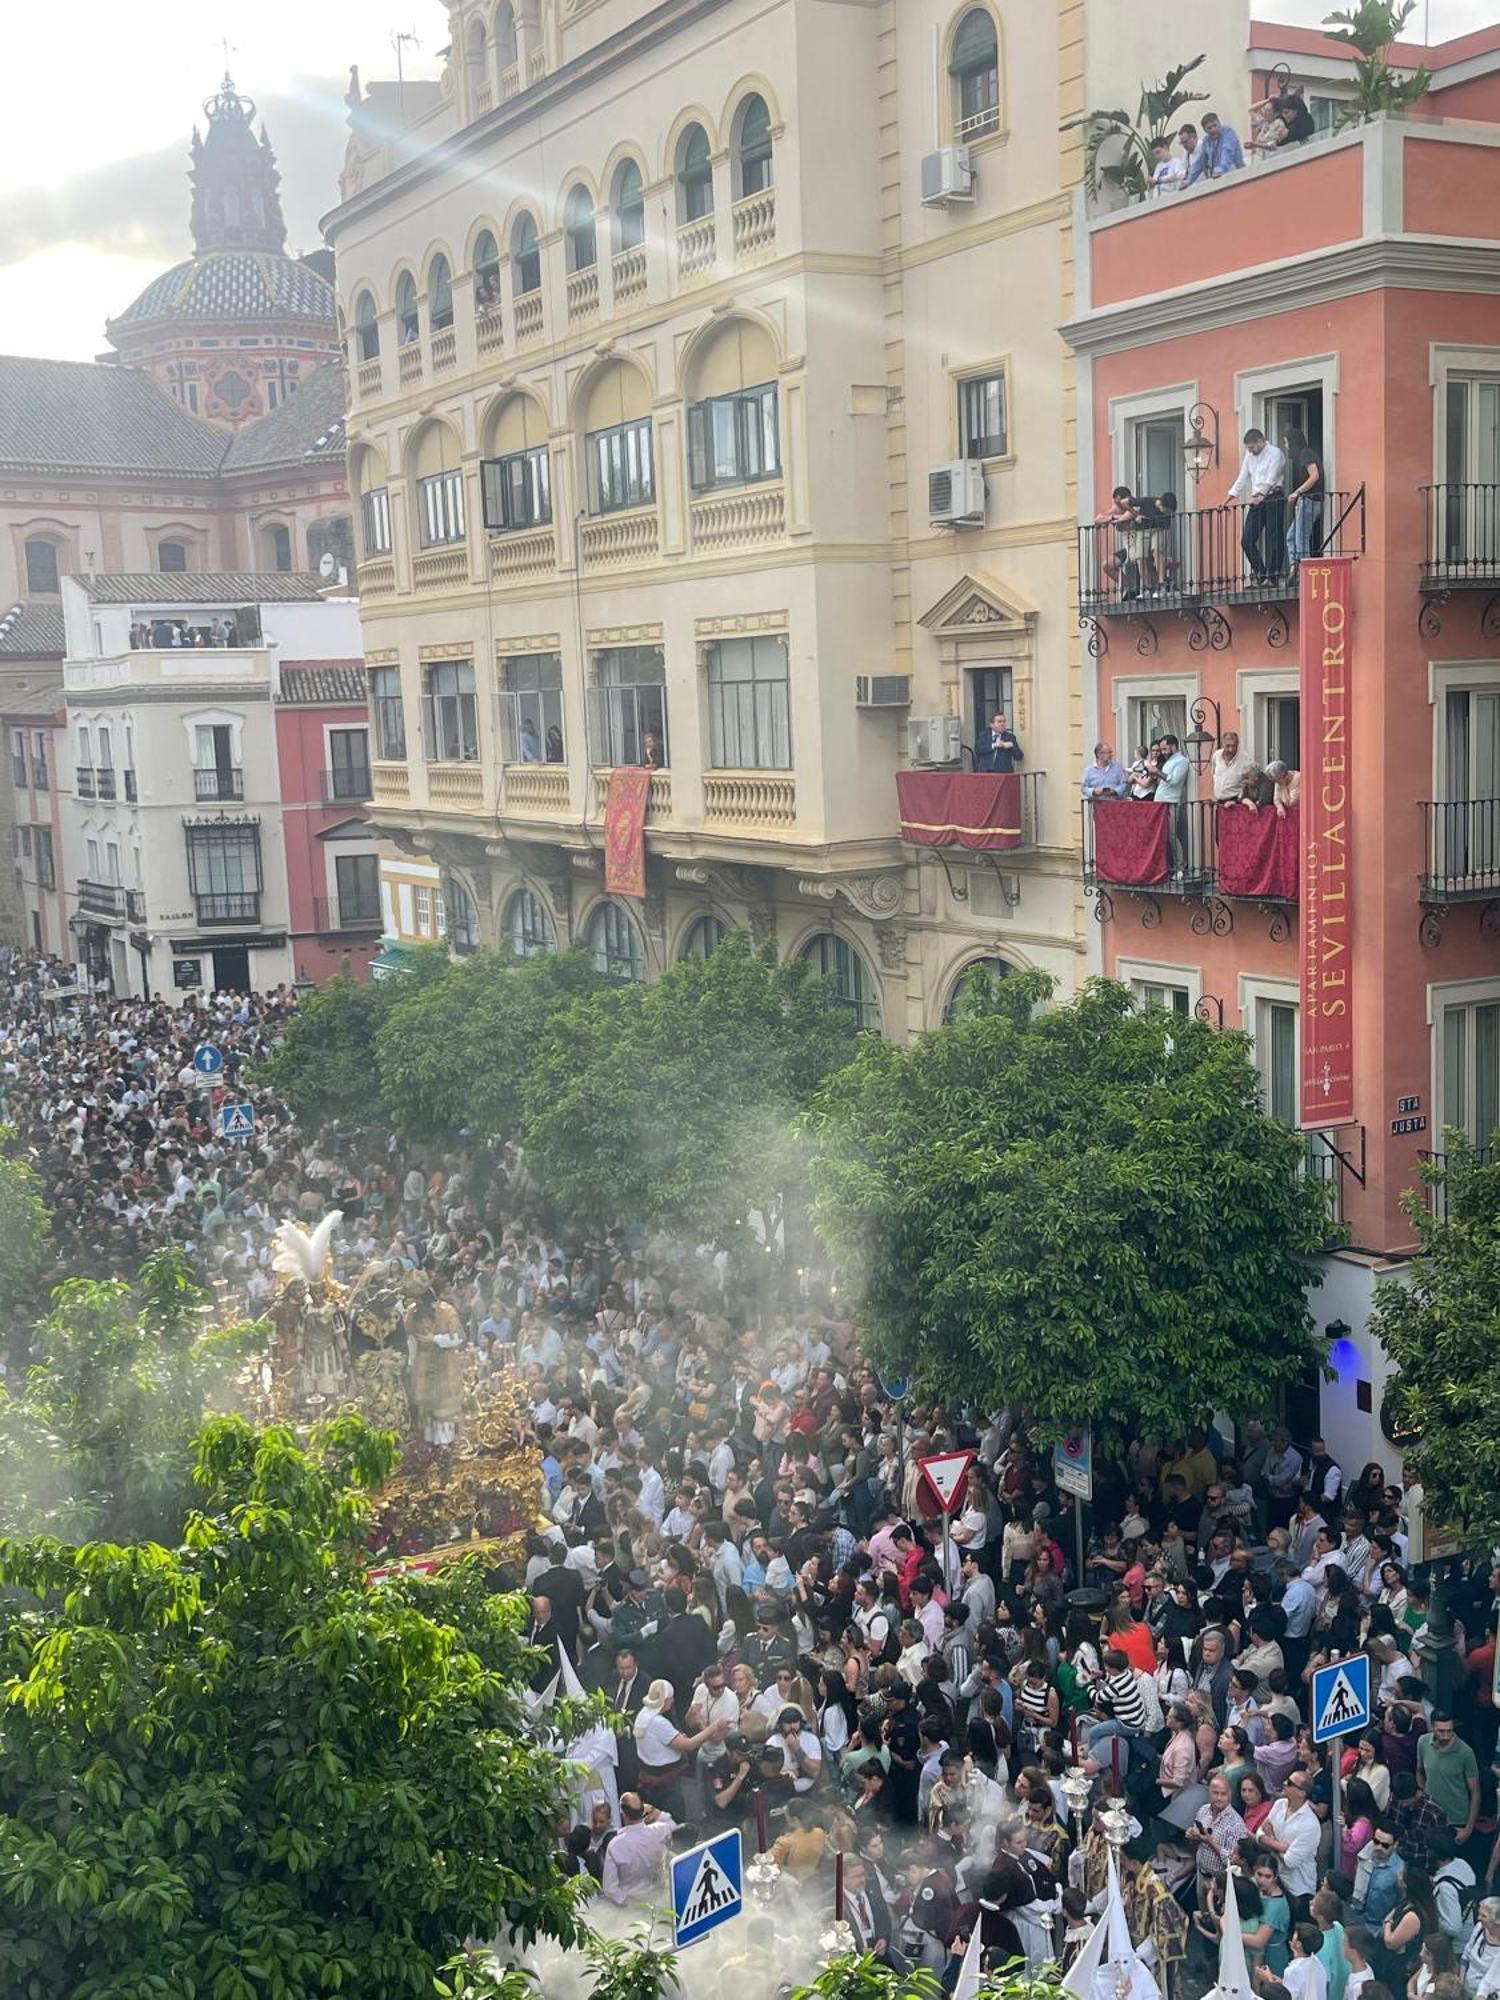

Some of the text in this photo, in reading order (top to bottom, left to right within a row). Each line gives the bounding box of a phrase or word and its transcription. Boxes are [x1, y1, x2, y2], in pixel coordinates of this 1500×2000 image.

[1322, 602, 1346, 1016] SEVILLACENTRO
[1307, 842, 1319, 1018] APARTAMENTOS
[1392, 1116, 1425, 1134] JUSTA
[1399, 1097, 1419, 1112] STA
